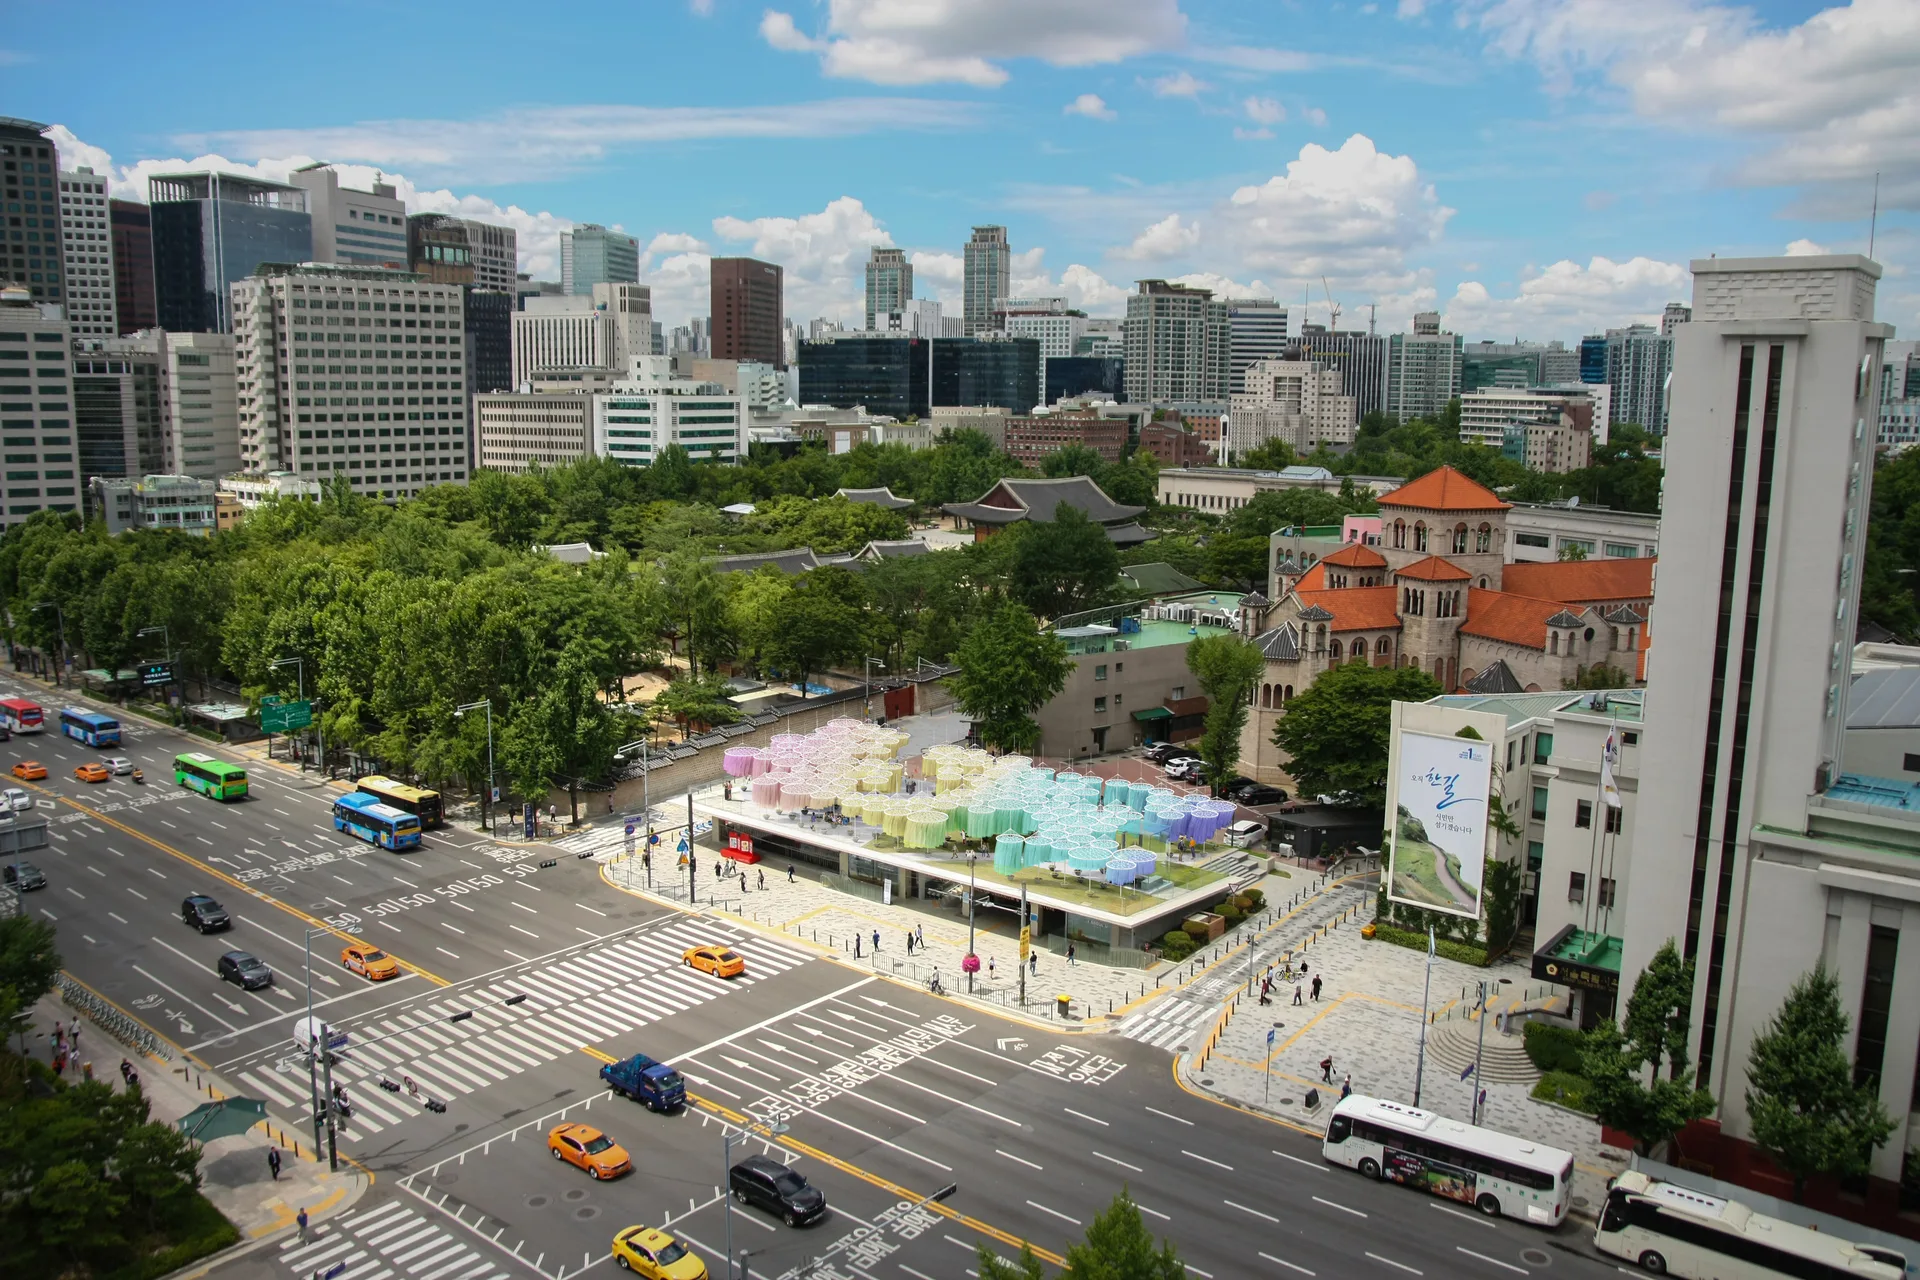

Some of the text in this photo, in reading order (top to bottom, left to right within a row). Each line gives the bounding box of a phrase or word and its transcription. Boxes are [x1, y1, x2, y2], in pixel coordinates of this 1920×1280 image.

[1411, 767, 1484, 810] 오직 한길
[1434, 821, 1473, 835] 섬기겠습니다
[1435, 812, 1454, 822] 시민만
[468, 874, 504, 889] 50
[502, 863, 538, 878] 50
[399, 893, 436, 908] 50
[434, 884, 470, 898] 50
[323, 912, 362, 928] 50
[362, 902, 400, 917] 50
[921, 1014, 976, 1039] 서소문
[888, 1029, 946, 1056] 서소문
[856, 1043, 915, 1072] 숭례문
[1029, 1044, 1091, 1075] 자전거
[1068, 1054, 1128, 1086] 우선도로
[820, 1060, 881, 1089] 숭례문
[781, 1078, 843, 1108] 소공로
[741, 1096, 803, 1125] 소공로
[873, 1200, 945, 1241] 광화문
